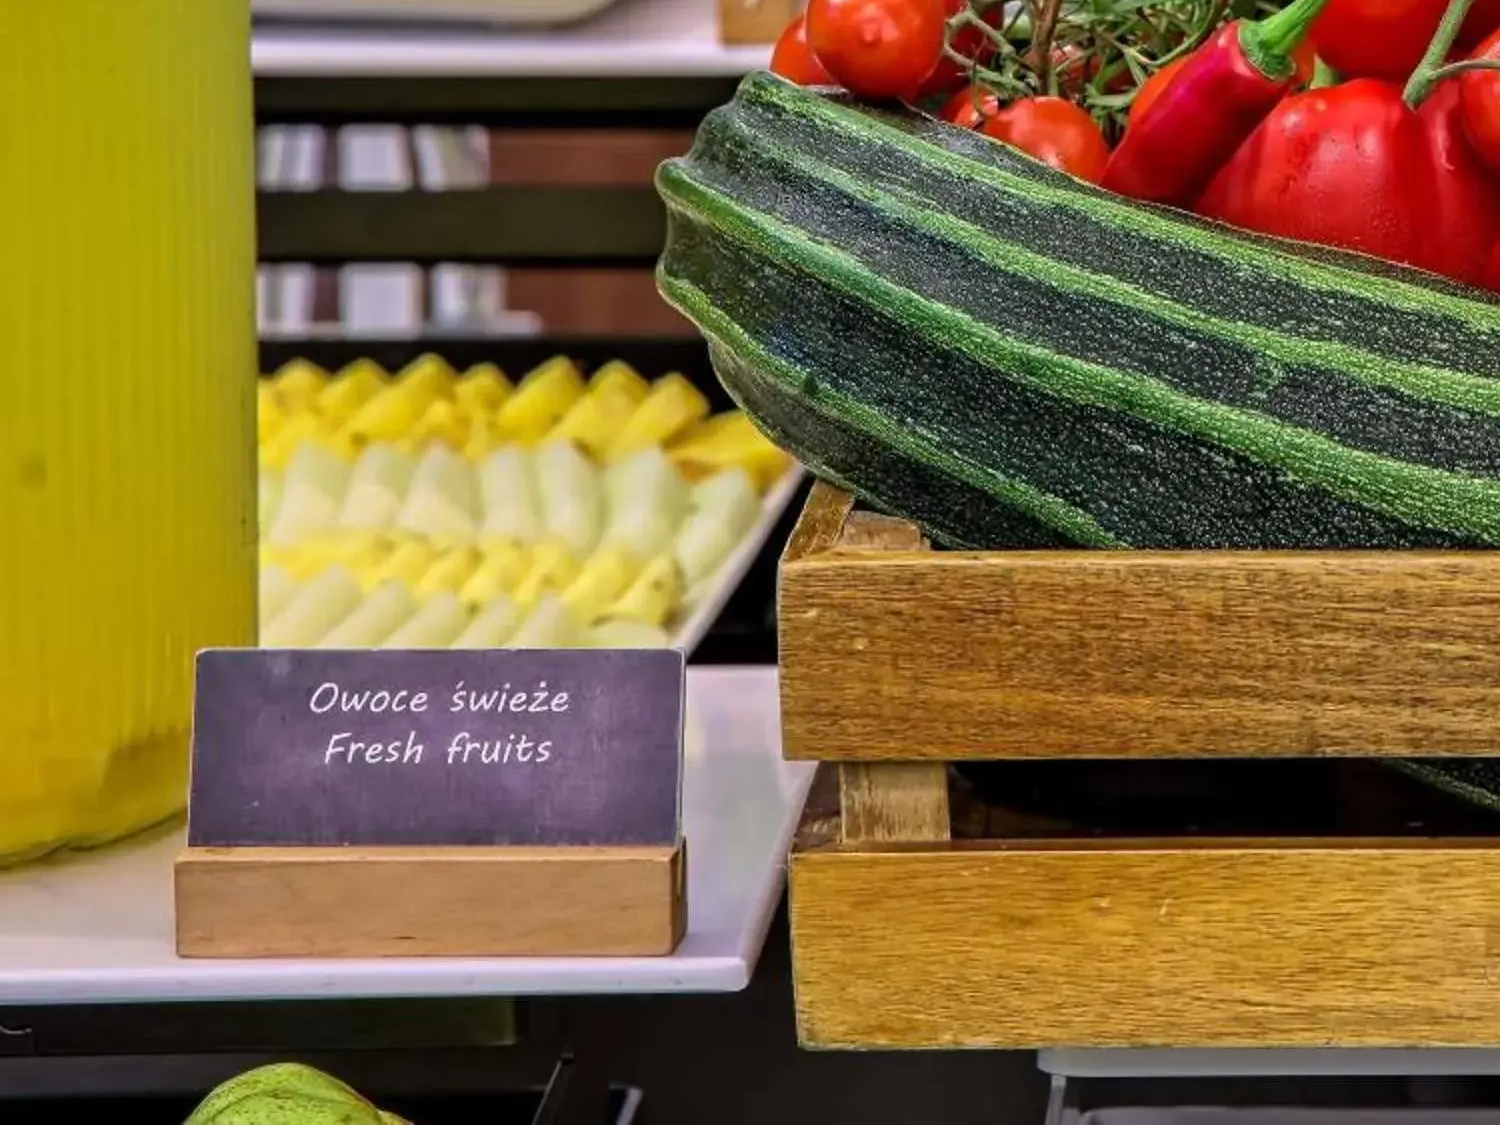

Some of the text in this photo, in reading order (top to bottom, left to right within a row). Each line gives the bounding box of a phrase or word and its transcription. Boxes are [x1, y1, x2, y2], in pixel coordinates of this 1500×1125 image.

[309, 680, 570, 714] Owoce świeże
[323, 730, 553, 765] Fresh fruits
